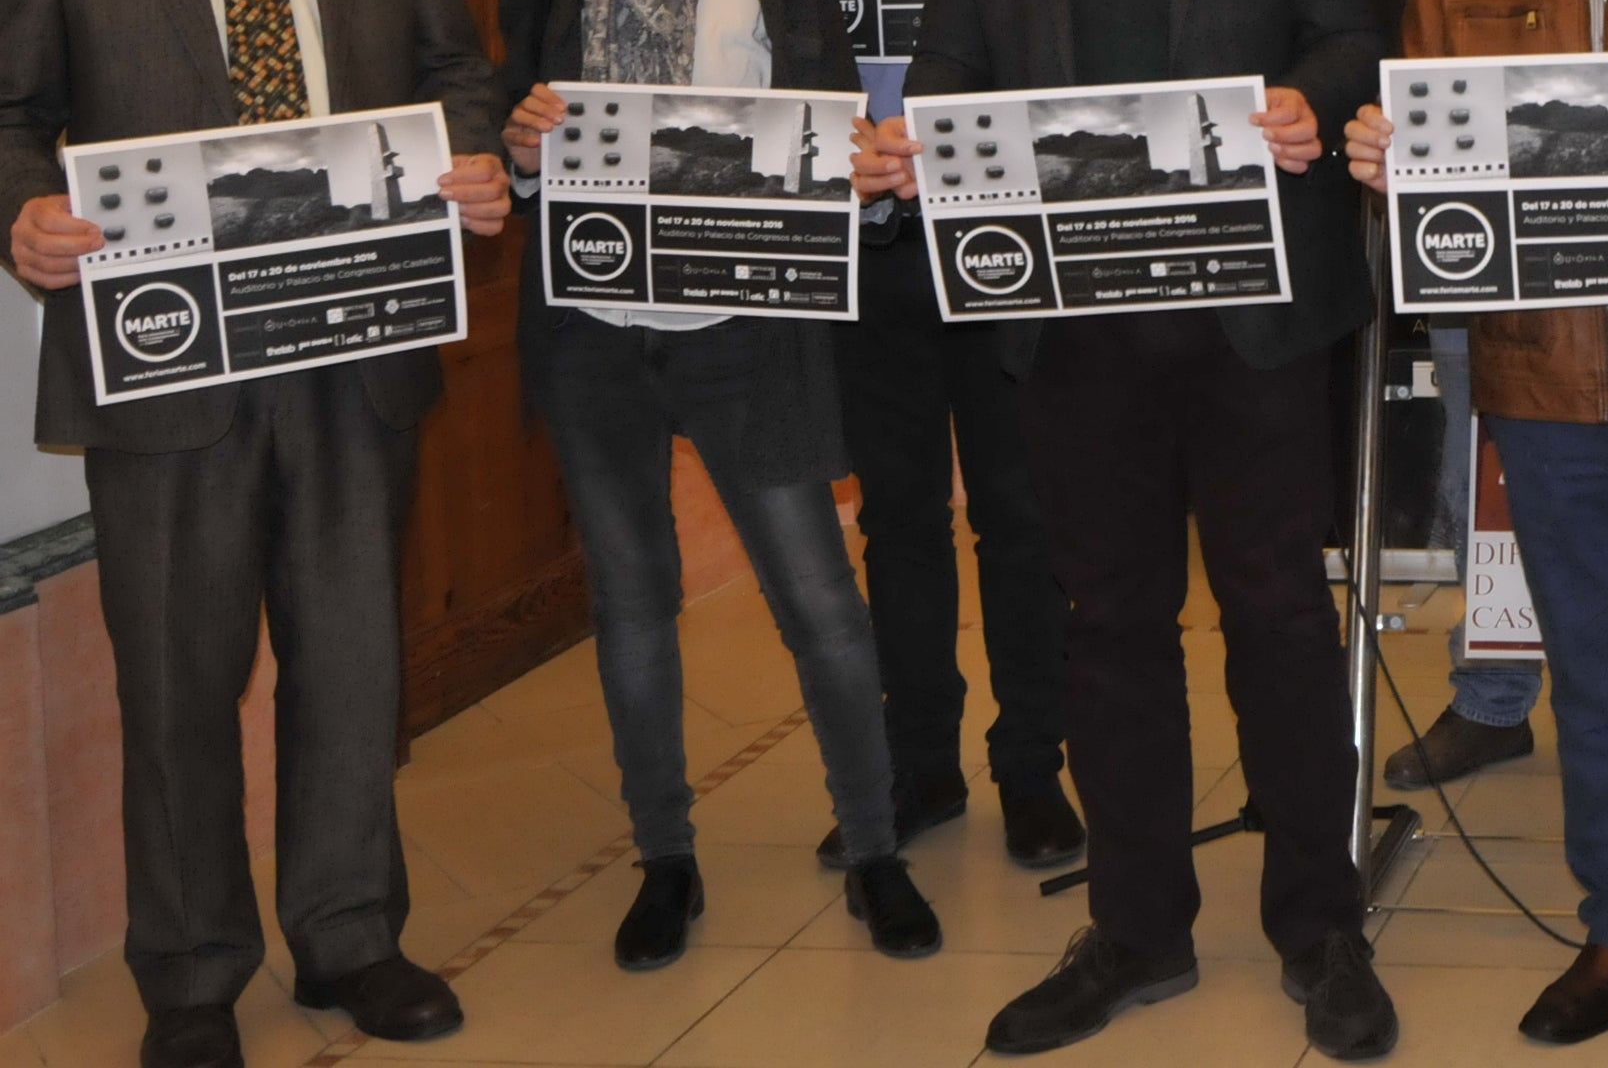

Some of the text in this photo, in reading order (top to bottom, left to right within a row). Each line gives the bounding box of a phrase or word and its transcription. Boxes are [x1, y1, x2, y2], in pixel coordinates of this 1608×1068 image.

[1521, 202, 1539, 211] Del
[1539, 201, 1551, 210] 17
[1560, 201, 1573, 210] 20
[1574, 200, 1588, 209] de
[571, 239, 625, 255] MARTE
[1425, 233, 1486, 250] MARTE
[964, 252, 1025, 269] MARTE
[124, 309, 191, 336] MARTE
